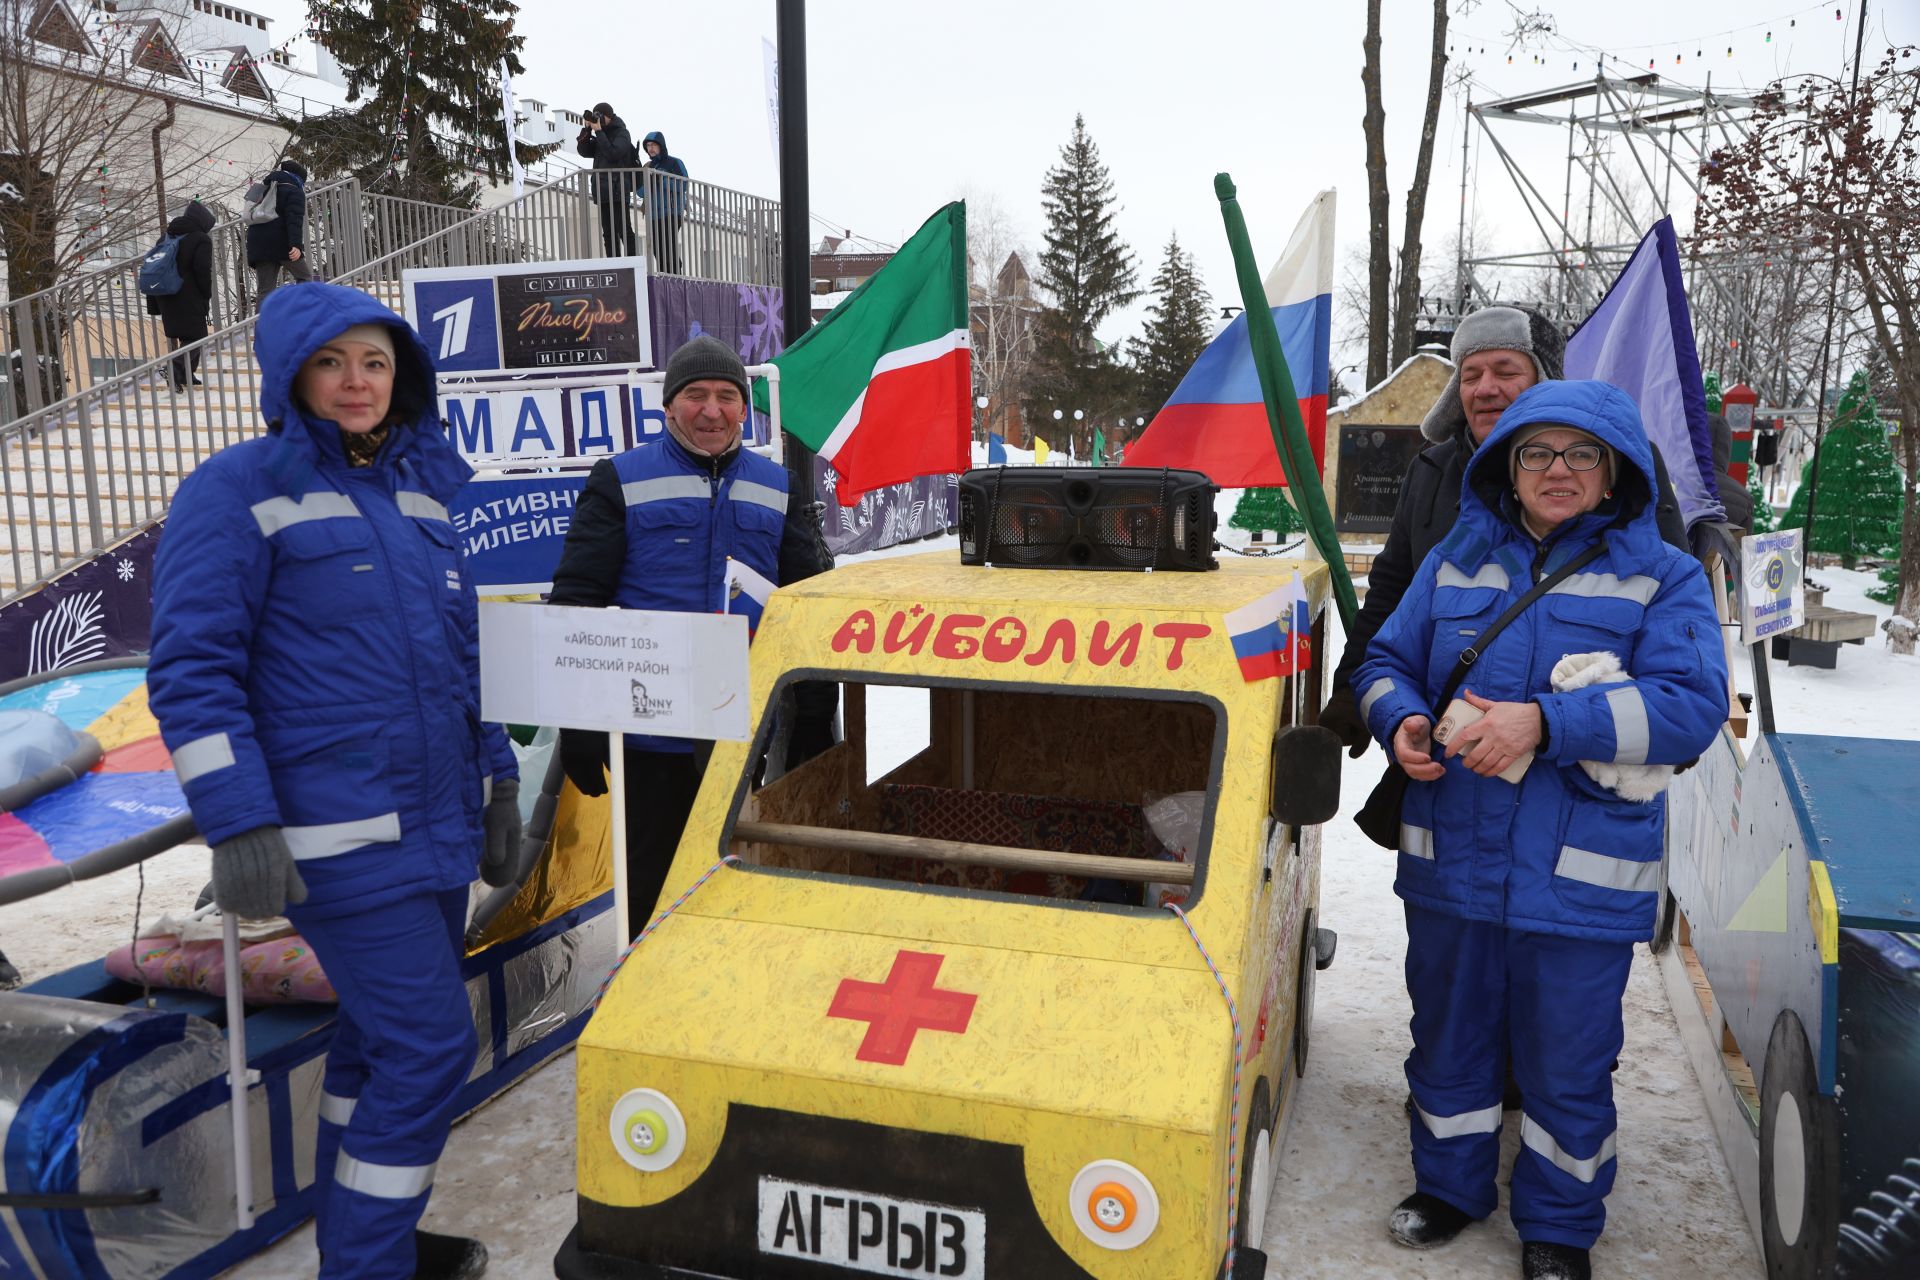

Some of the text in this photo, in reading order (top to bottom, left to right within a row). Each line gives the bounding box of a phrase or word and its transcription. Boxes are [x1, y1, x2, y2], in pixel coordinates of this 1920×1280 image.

[528, 276, 613, 291] СУПЕР
[517, 298, 625, 341] Поле Чудес
[541, 351, 603, 363] ИГРА
[564, 632, 659, 650] «АЙБОЛИТ 103»
[831, 604, 1211, 670] АЙБОЛИТ
[555, 655, 670, 675] АГРЫЗСКИЙ РАЙОН
[632, 696, 673, 709] SUNNY
